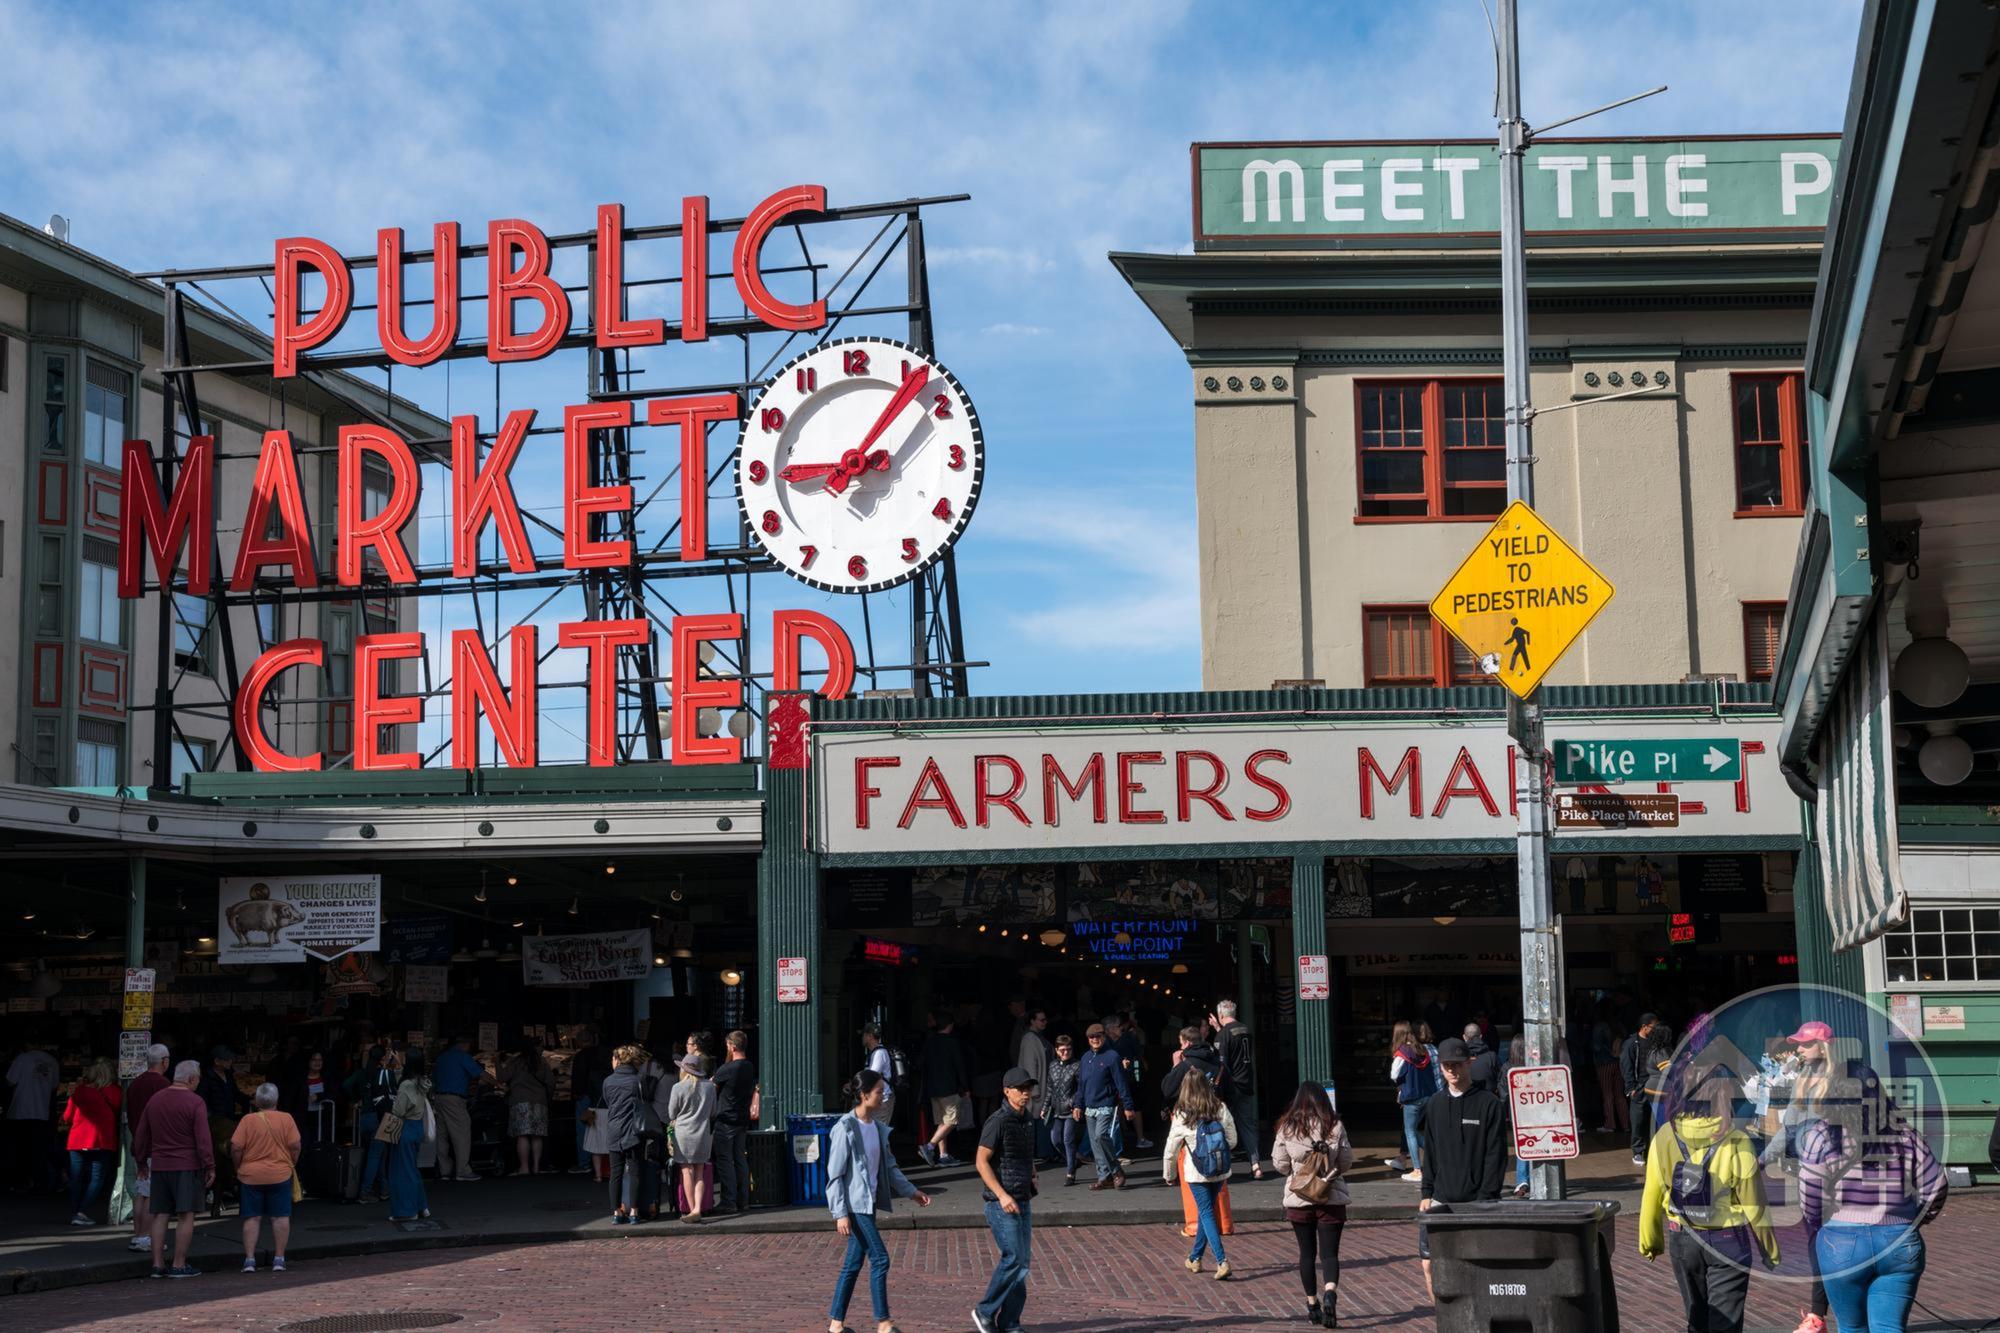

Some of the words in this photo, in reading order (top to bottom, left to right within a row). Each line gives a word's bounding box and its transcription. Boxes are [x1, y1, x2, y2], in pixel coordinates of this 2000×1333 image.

[1242, 157, 1479, 223] MEET
[1538, 154, 1708, 219] THE
[273, 184, 829, 378] PUBLIC
[843, 350, 869, 376] 12
[797, 367, 816, 393] 11
[934, 395, 951, 418] 2
[761, 408, 784, 431] 10
[948, 444, 964, 469] 3
[749, 460, 766, 483] 9
[117, 393, 740, 600] MARKET
[932, 498, 951, 521] 4
[762, 510, 780, 534] 8
[799, 545, 818, 568] 7
[901, 538, 918, 562] 5
[1491, 533, 1549, 559] YIELD
[848, 555, 866, 579] 6
[1507, 561, 1531, 584] TO
[1453, 584, 1589, 616] PEDESTRIANS
[235, 609, 856, 772] CENTER
[1566, 743, 1635, 775] Pike
[1654, 752, 1677, 774] Pl
[855, 748, 1292, 829] FARMERS
[1575, 799, 1620, 807] HISTORICAL
[1624, 799, 1659, 807] DISTRICT
[1561, 811, 1589, 821] Pike
[1592, 811, 1626, 822] Place
[1628, 810, 1675, 821] Market
[284, 883, 321, 900] YOUR
[323, 883, 375, 899] CHANGE
[300, 900, 344, 908] CHANGES
[346, 899, 376, 907] LIVES!
[1072, 919, 1199, 936] WATERFRONT
[538, 947, 591, 965] Copper
[597, 945, 640, 961] River
[1089, 937, 1183, 953] VIEWPOINT
[1138, 952, 1169, 960] SEATING
[561, 966, 619, 982] Salmon
[1303, 966, 1324, 974] STOPS
[1520, 1090, 1564, 1105] STOPS
